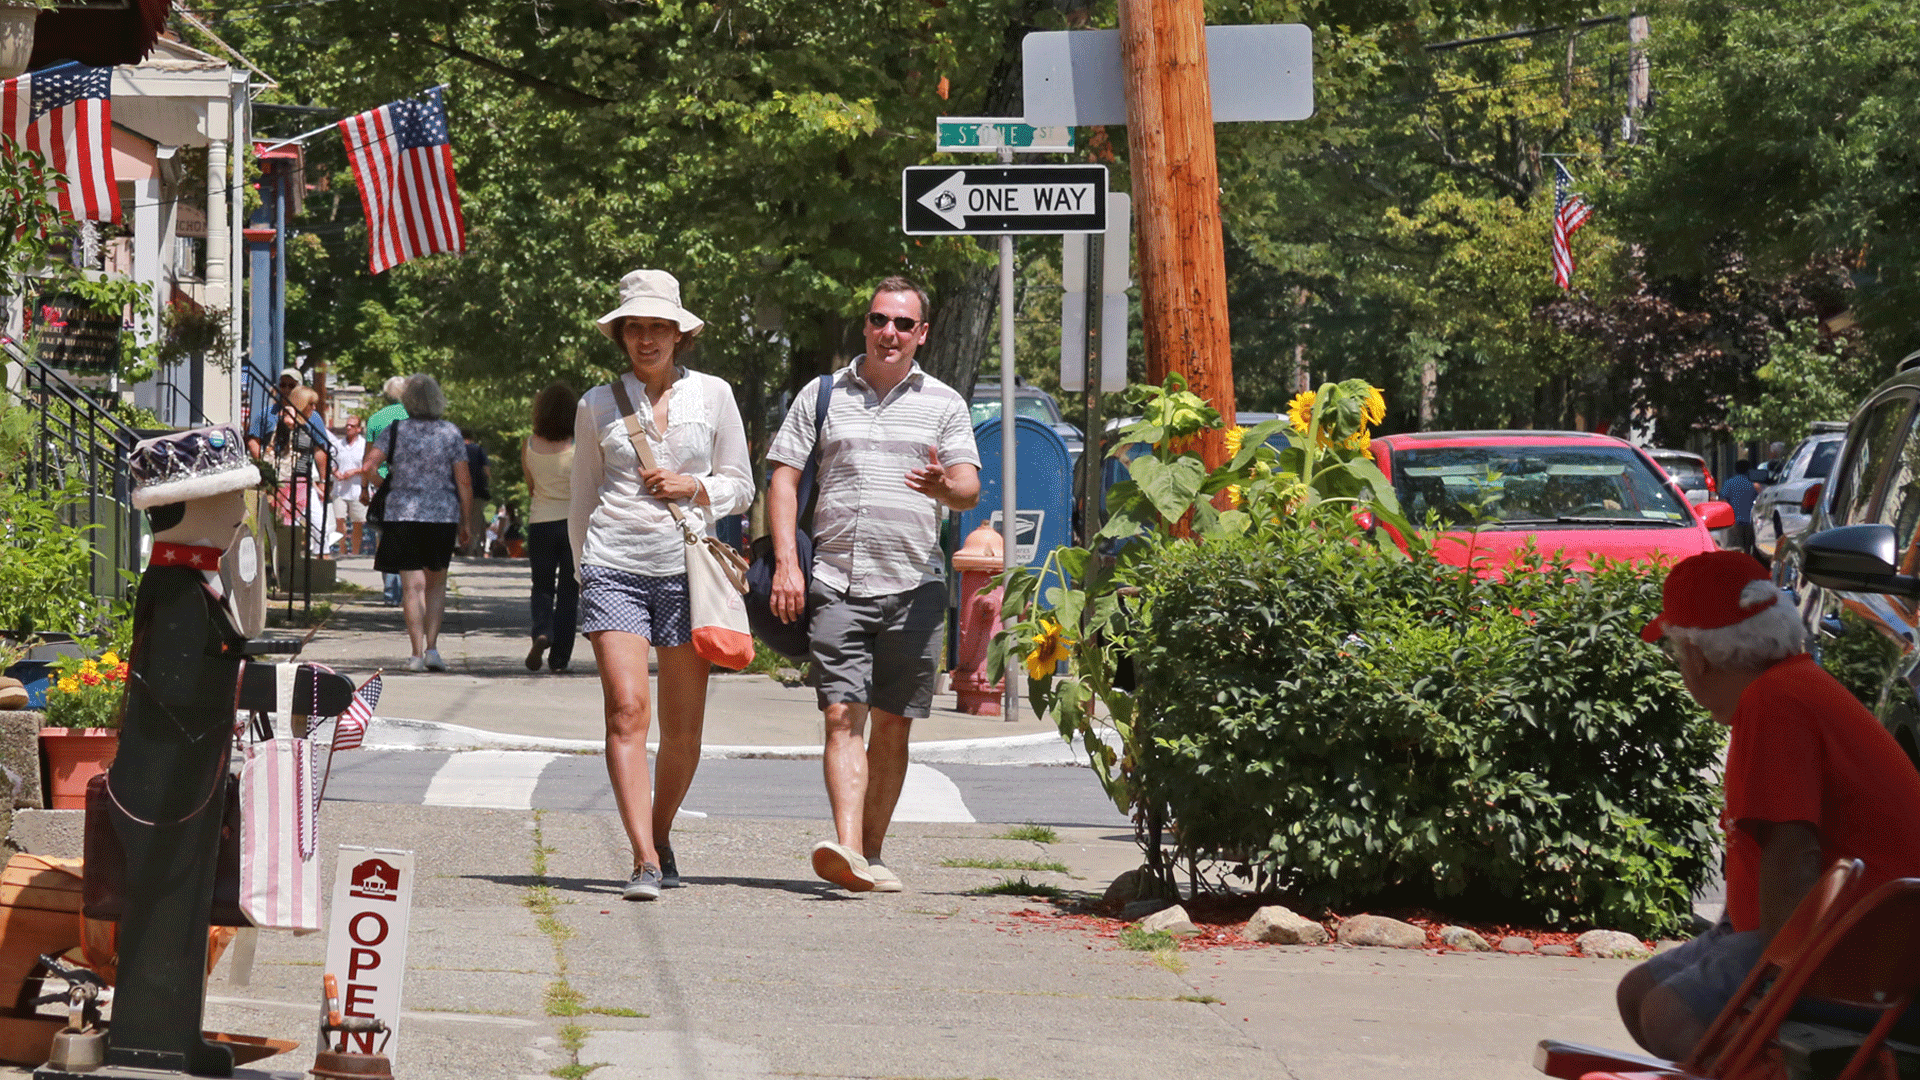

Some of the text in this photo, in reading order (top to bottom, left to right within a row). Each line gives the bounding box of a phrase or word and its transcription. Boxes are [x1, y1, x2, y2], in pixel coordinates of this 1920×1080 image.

[958, 125, 1055, 144] STONE ST
[968, 187, 1087, 212] ONE WAY
[340, 911, 389, 1055] OPEN
